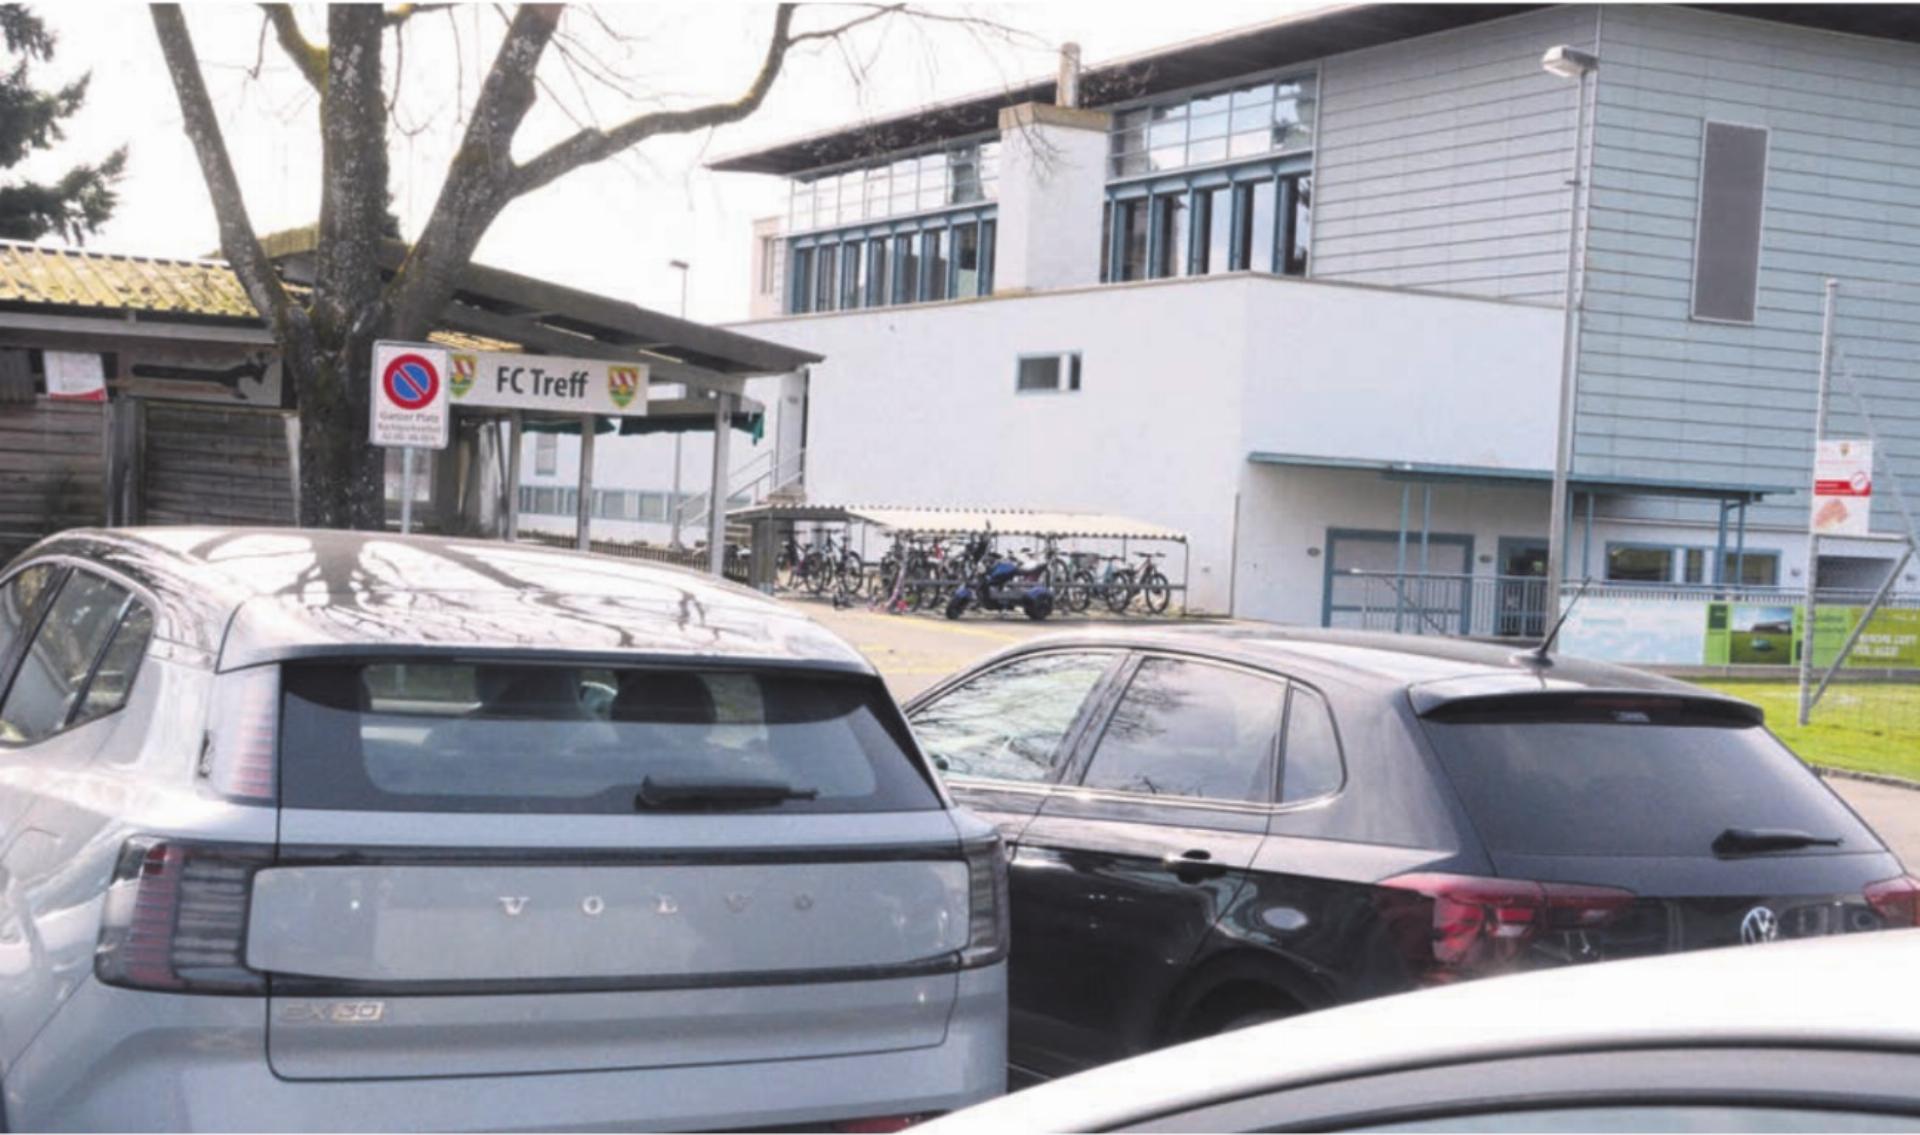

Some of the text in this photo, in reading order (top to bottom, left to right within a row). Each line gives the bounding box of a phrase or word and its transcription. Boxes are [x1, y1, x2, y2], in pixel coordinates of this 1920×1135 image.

[496, 366, 589, 398] FC Treff
[500, 895, 815, 915] VOLVO
